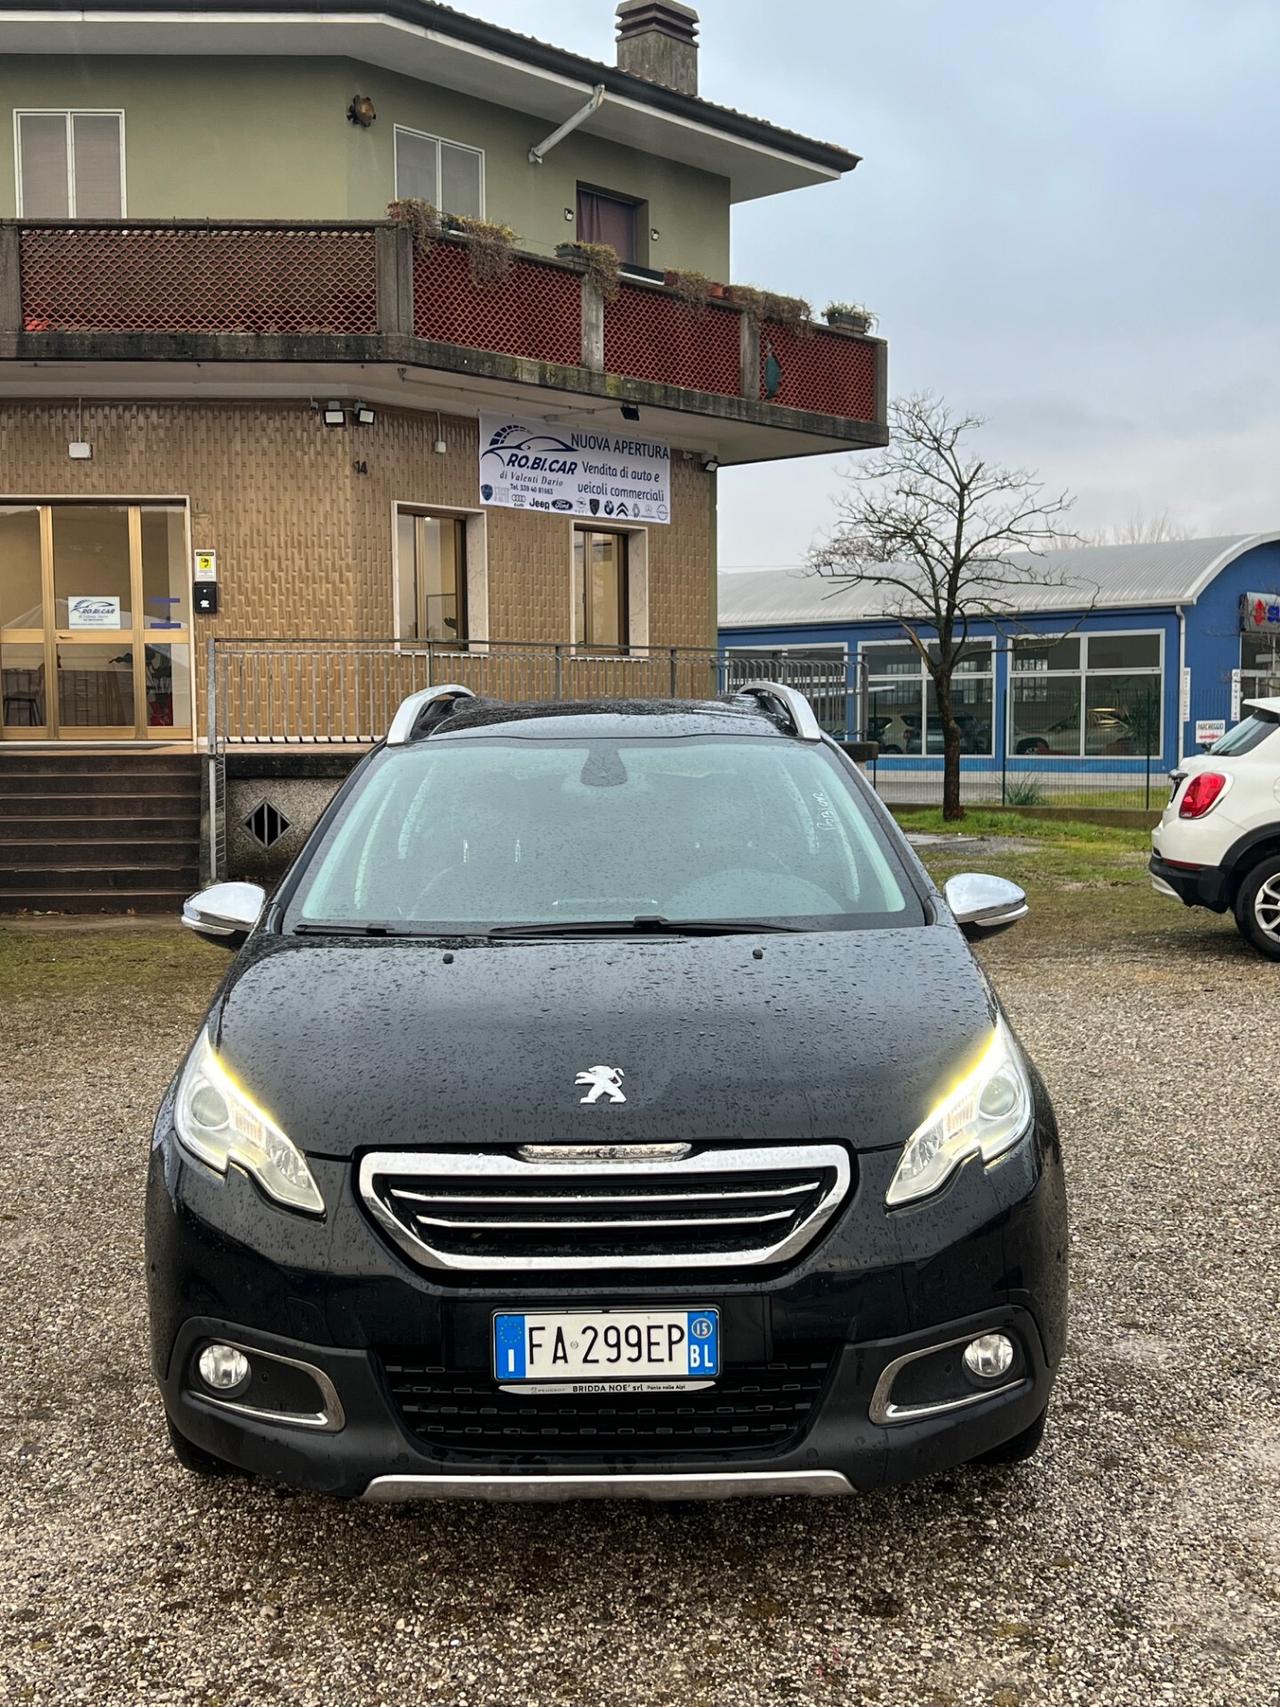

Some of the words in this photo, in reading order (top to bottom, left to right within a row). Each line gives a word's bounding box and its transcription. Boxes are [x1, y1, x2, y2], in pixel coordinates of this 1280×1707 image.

[571, 433, 611, 452] NUOVA
[613, 439, 669, 459] APERTURA
[506, 453, 578, 475] RO.BI.CAR
[582, 460, 618, 477] Vendita
[620, 465, 629, 479] di
[631, 469, 652, 482] auto
[654, 472, 660, 483] e
[499, 471, 508, 480] di
[511, 471, 539, 484] Valenti
[541, 475, 564, 487] Dario
[509, 483, 519, 491] Tel.
[520, 484, 530, 493] 339
[577, 480, 608, 496] veicoli
[610, 486, 665, 502] commerciali
[529, 497, 550, 510] Jeep
[696, 1322, 708, 1336] 15
[508, 1349, 515, 1372] I
[690, 1344, 714, 1368] BL
[572, 1384, 606, 1393] BRIDDA
[608, 1384, 631, 1392] NOE'
